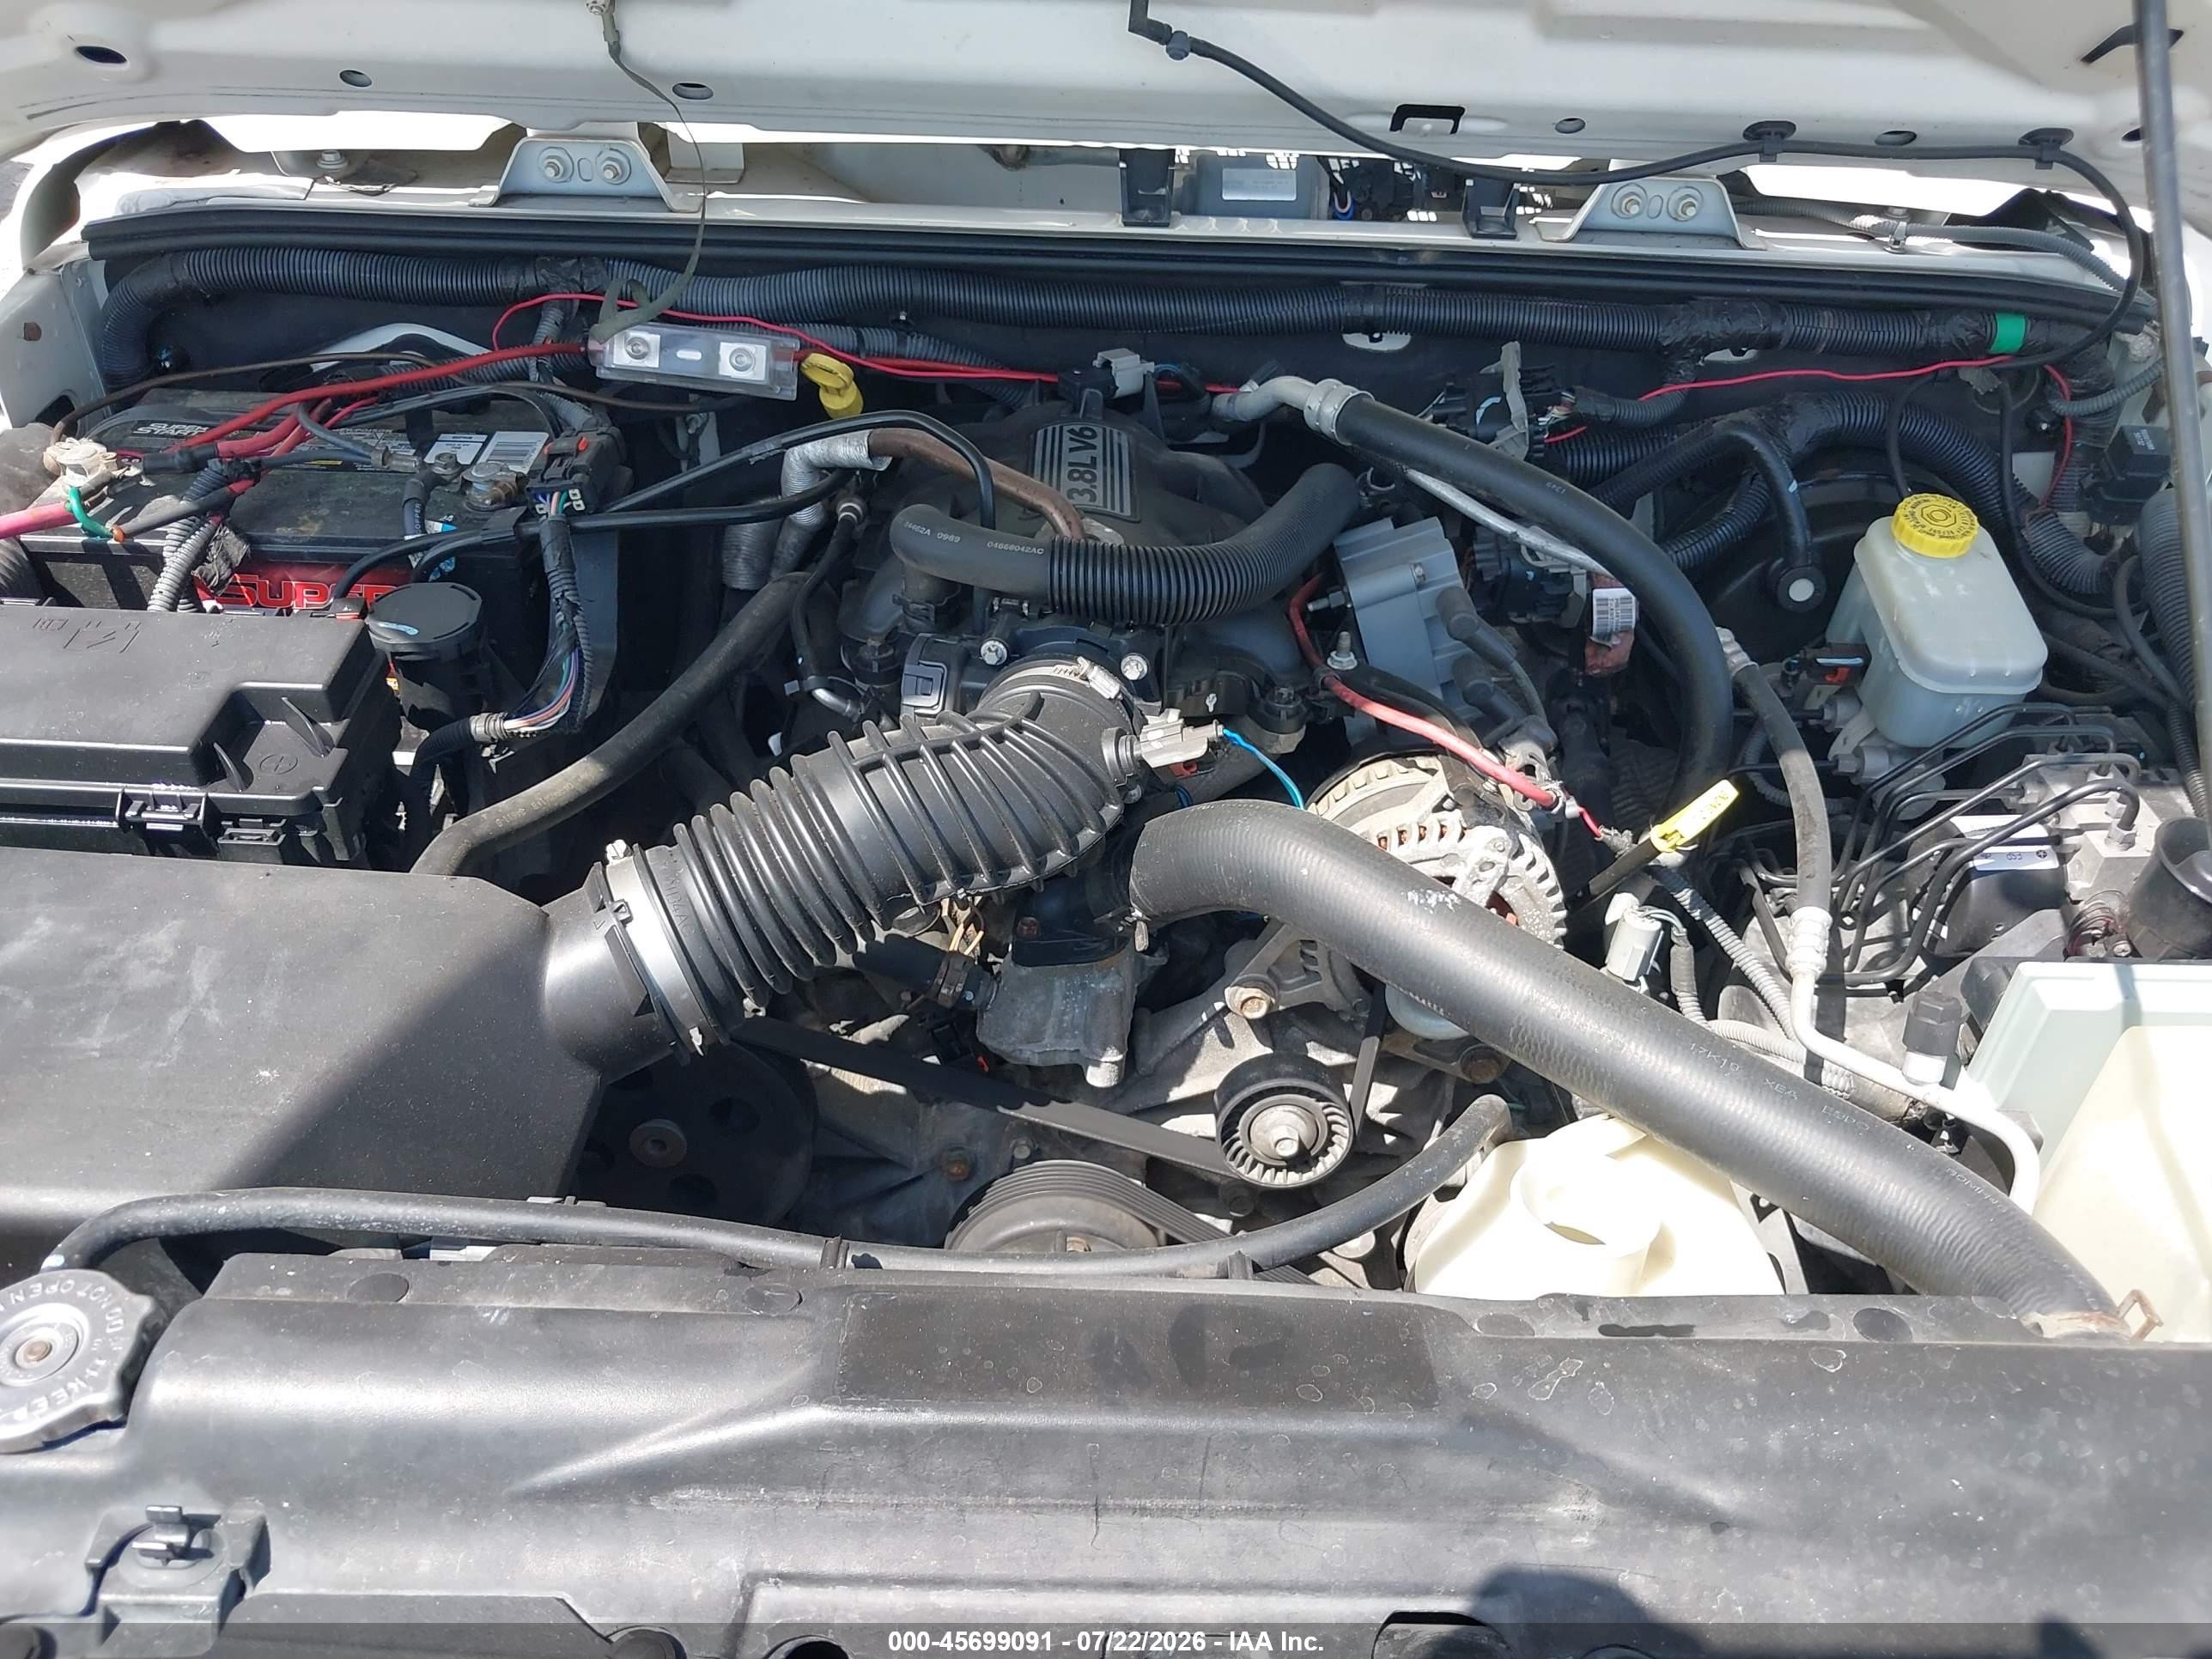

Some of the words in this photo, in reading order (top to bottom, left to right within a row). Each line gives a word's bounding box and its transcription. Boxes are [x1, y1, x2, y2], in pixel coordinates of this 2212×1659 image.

[133, 427, 208, 436] START
[1066, 426, 1097, 453] V6
[1066, 456, 1097, 502] 3.8L
[9, 1279, 75, 1304] OPEN
